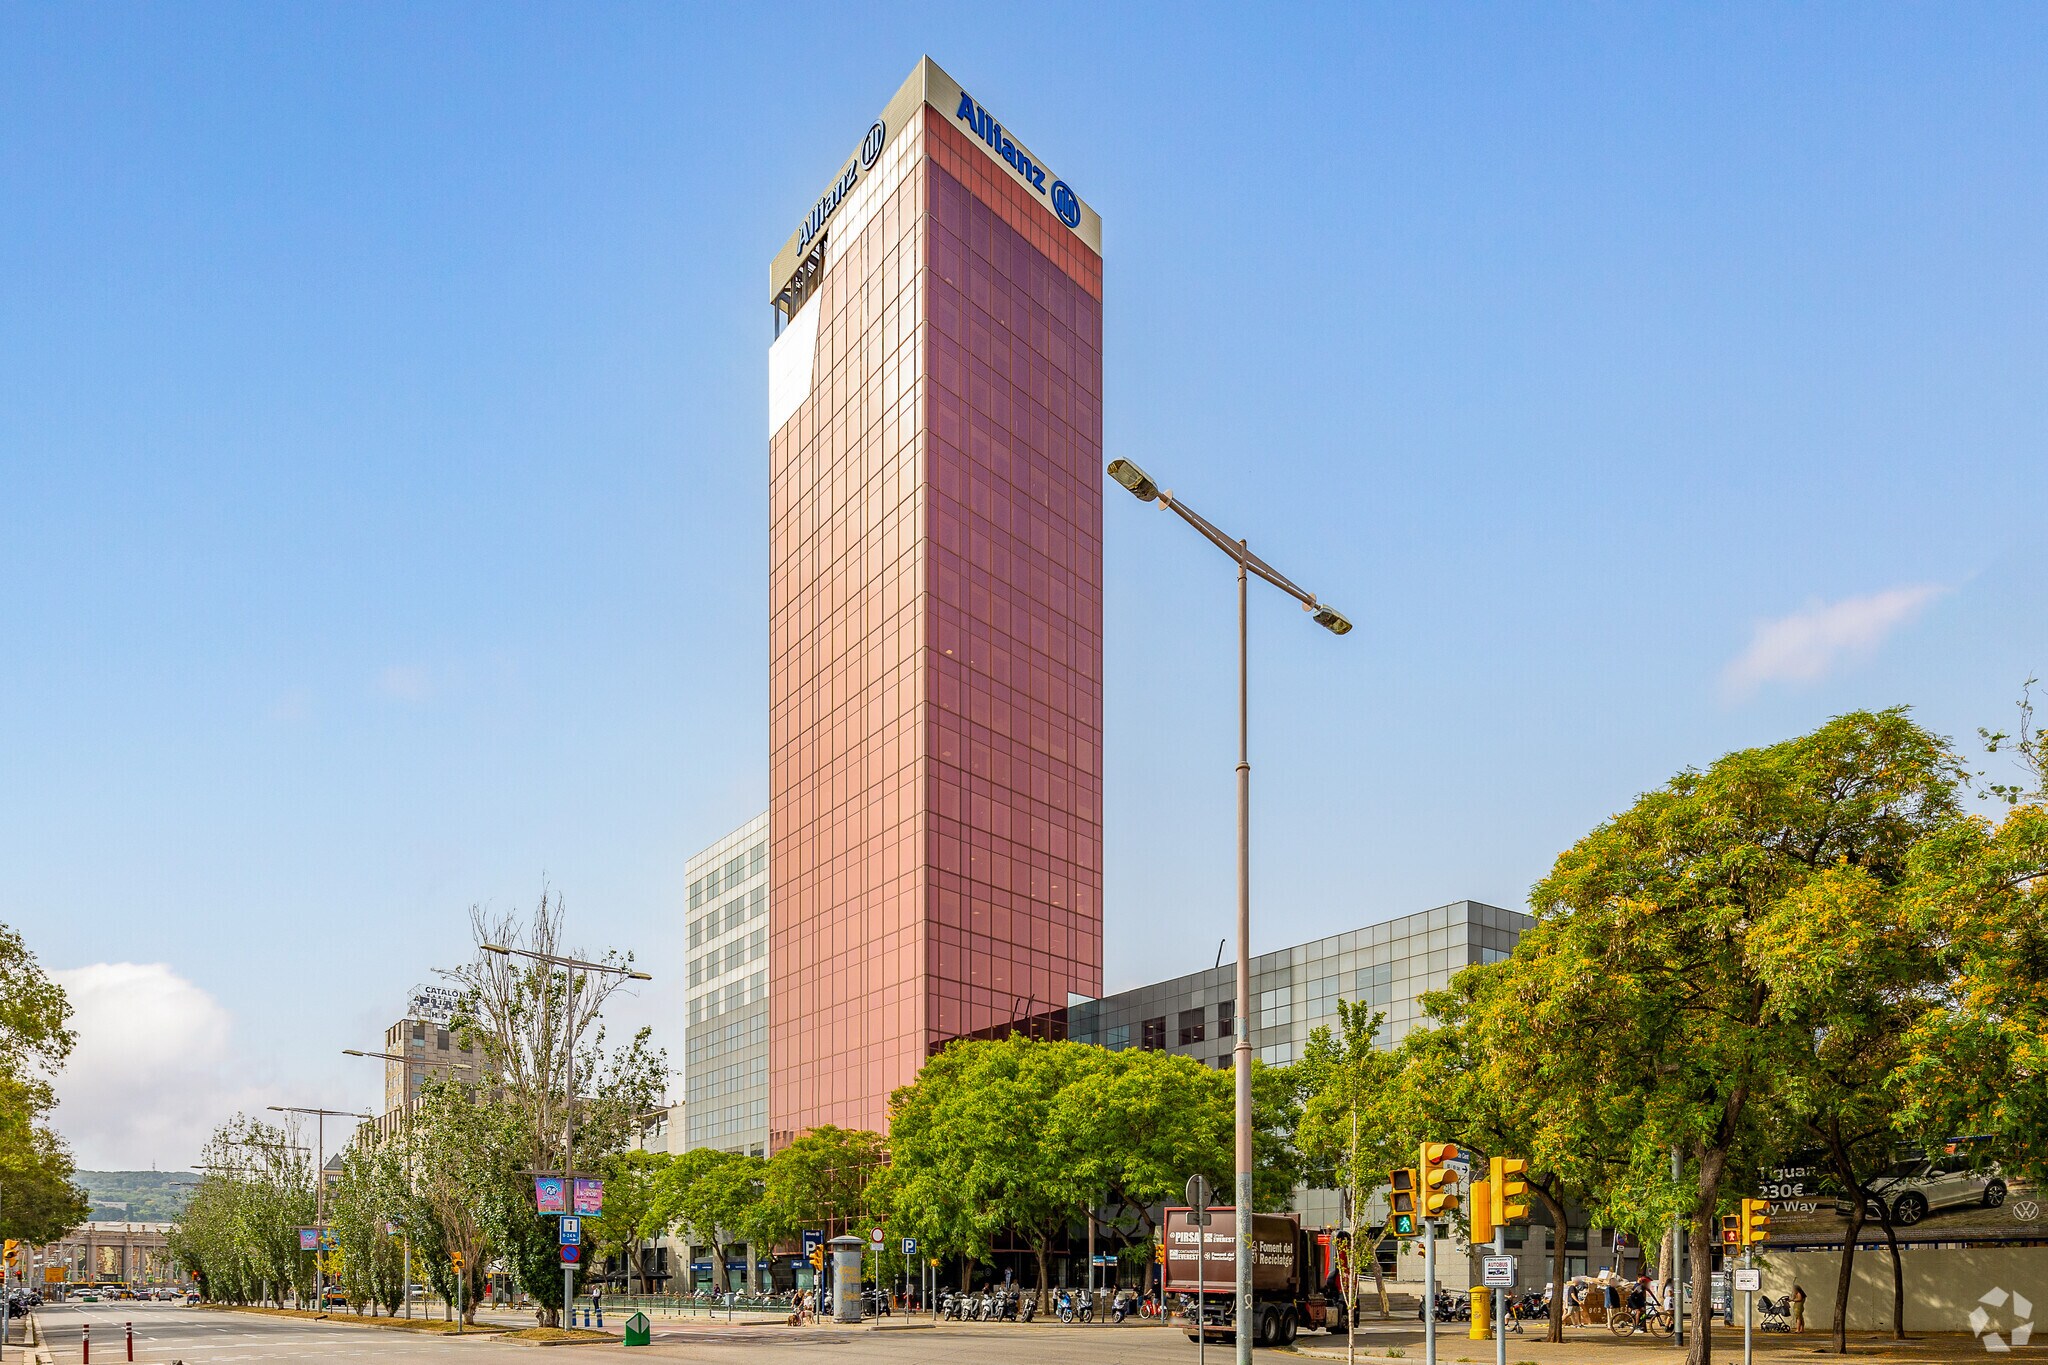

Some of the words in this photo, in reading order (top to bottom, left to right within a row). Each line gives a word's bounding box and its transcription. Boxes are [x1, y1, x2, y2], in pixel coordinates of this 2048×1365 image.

[957, 91, 1046, 195] Allianz
[797, 158, 857, 257] Allianz
[1783, 1201, 1818, 1214] Way
[1176, 1231, 1200, 1243] PIRSA
[806, 1241, 817, 1257] P
[905, 1240, 914, 1253] P
[1259, 1240, 1282, 1253] Foment
[1284, 1243, 1293, 1254] del
[1259, 1253, 1294, 1267] Reciclatge
